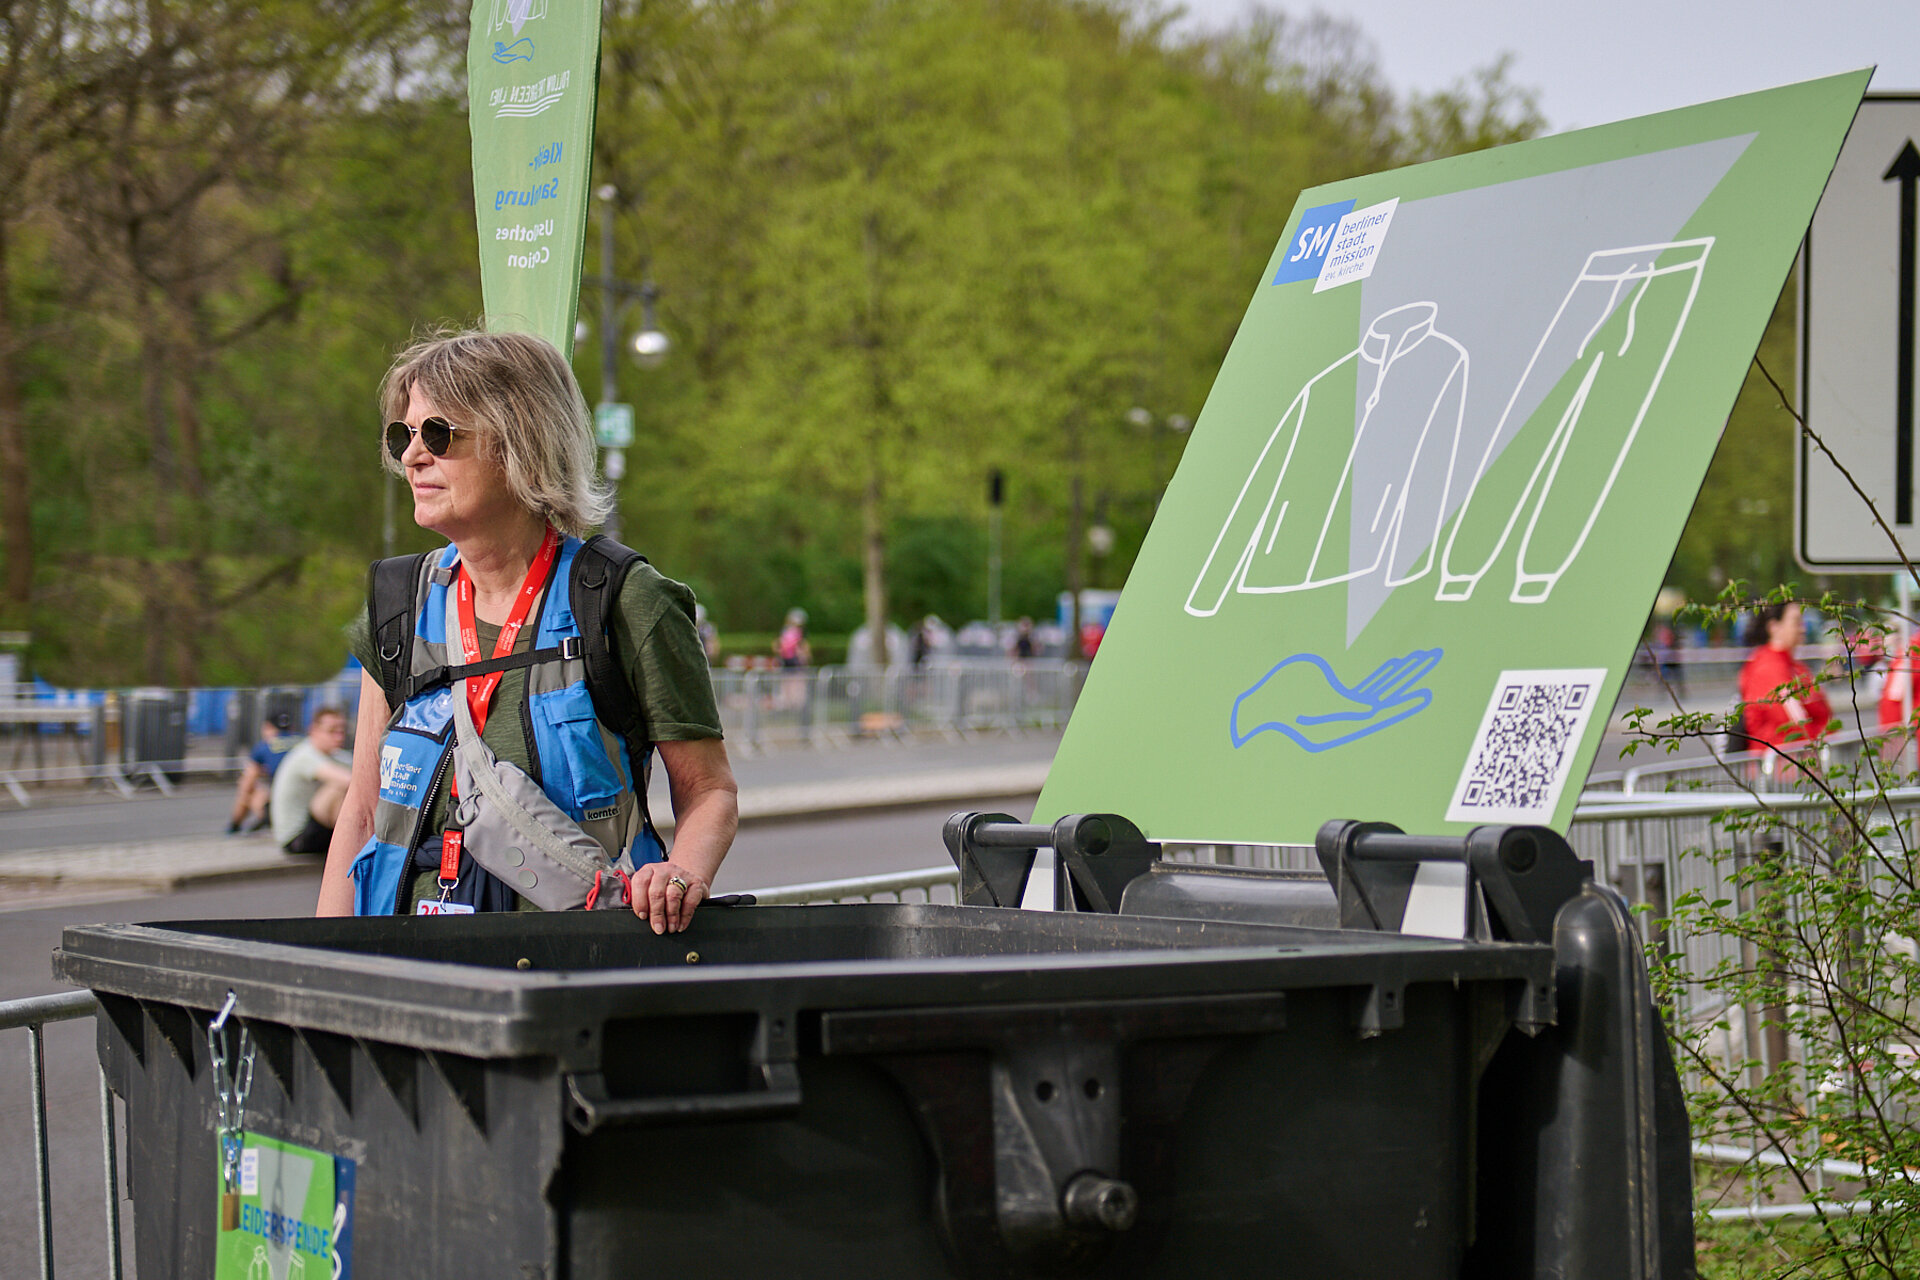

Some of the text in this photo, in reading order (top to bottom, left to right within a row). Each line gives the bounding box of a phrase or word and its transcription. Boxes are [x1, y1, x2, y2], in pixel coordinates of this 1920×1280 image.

[1342, 212, 1388, 236] berliner
[1290, 222, 1336, 263] SM
[1335, 232, 1367, 252] stadt
[1329, 244, 1375, 268] mission
[1338, 262, 1365, 277] kirche
[238, 1203, 330, 1259] EIDERSPENDE
